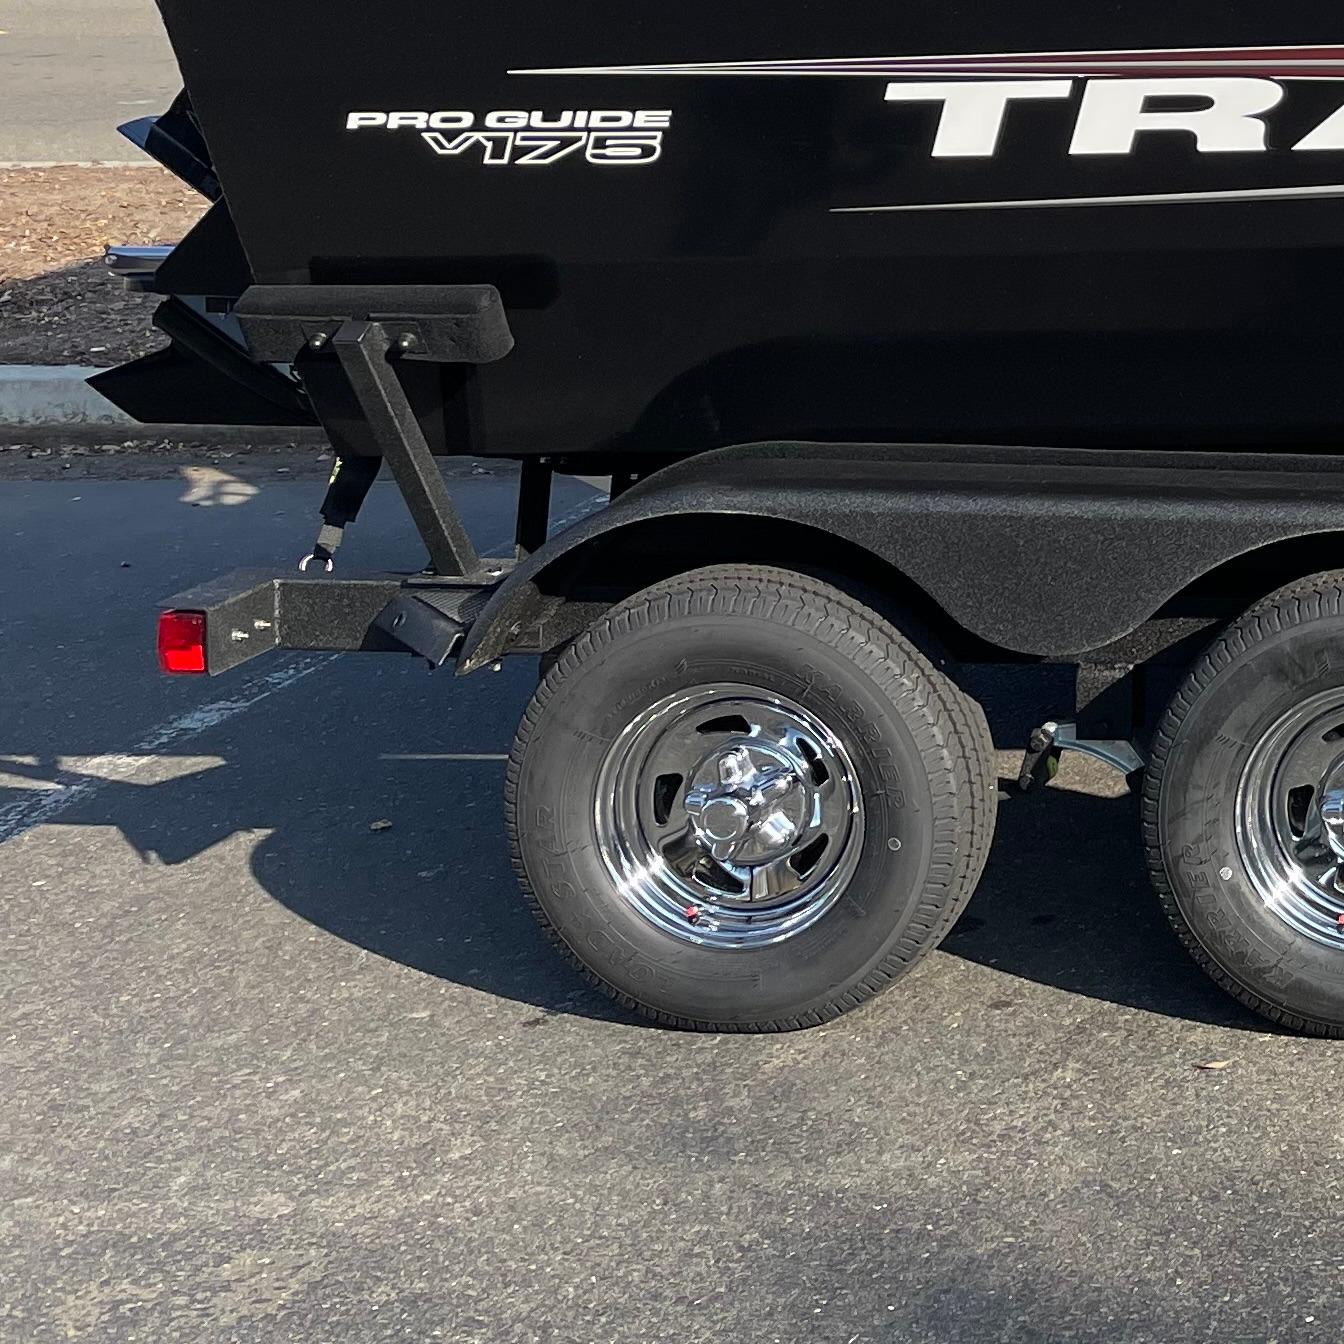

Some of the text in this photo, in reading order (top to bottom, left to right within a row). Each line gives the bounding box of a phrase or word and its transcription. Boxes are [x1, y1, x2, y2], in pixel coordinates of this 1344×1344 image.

[346, 110, 673, 129] PRO GUIDE
[421, 131, 663, 164] V175
[801, 662, 906, 810] KARRIER
[1181, 843, 1296, 990] KARRIER
